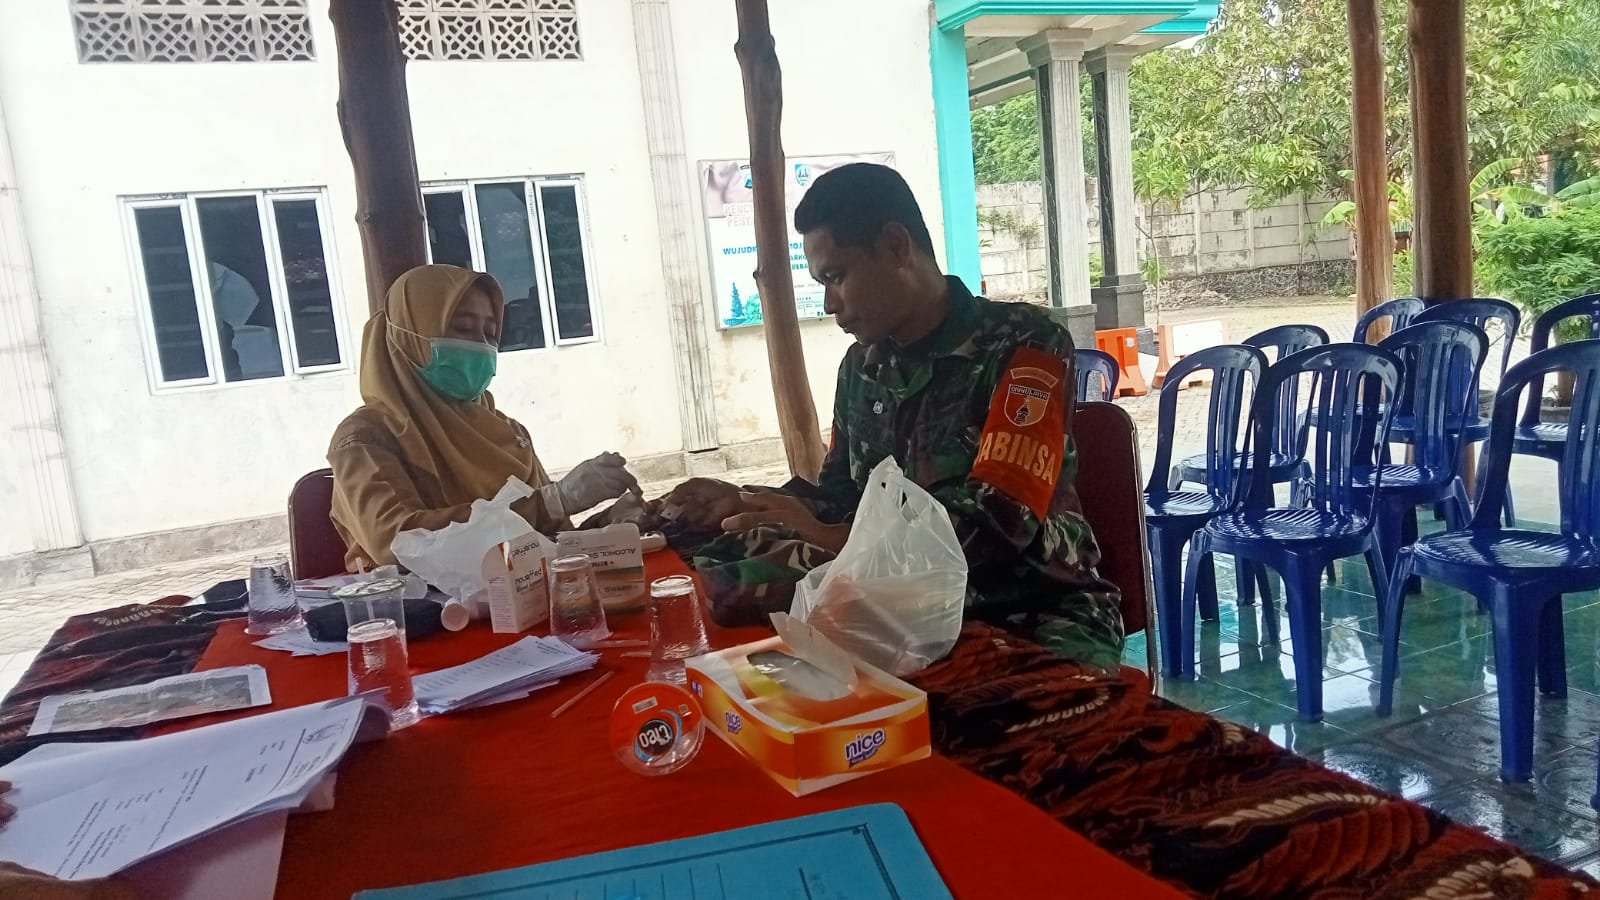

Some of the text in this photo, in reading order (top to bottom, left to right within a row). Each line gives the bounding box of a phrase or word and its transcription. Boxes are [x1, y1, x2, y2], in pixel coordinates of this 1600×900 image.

[975, 432, 1057, 485] ABINSA
[600, 547, 636, 557] ALCOHOL
[845, 729, 884, 759] nice
